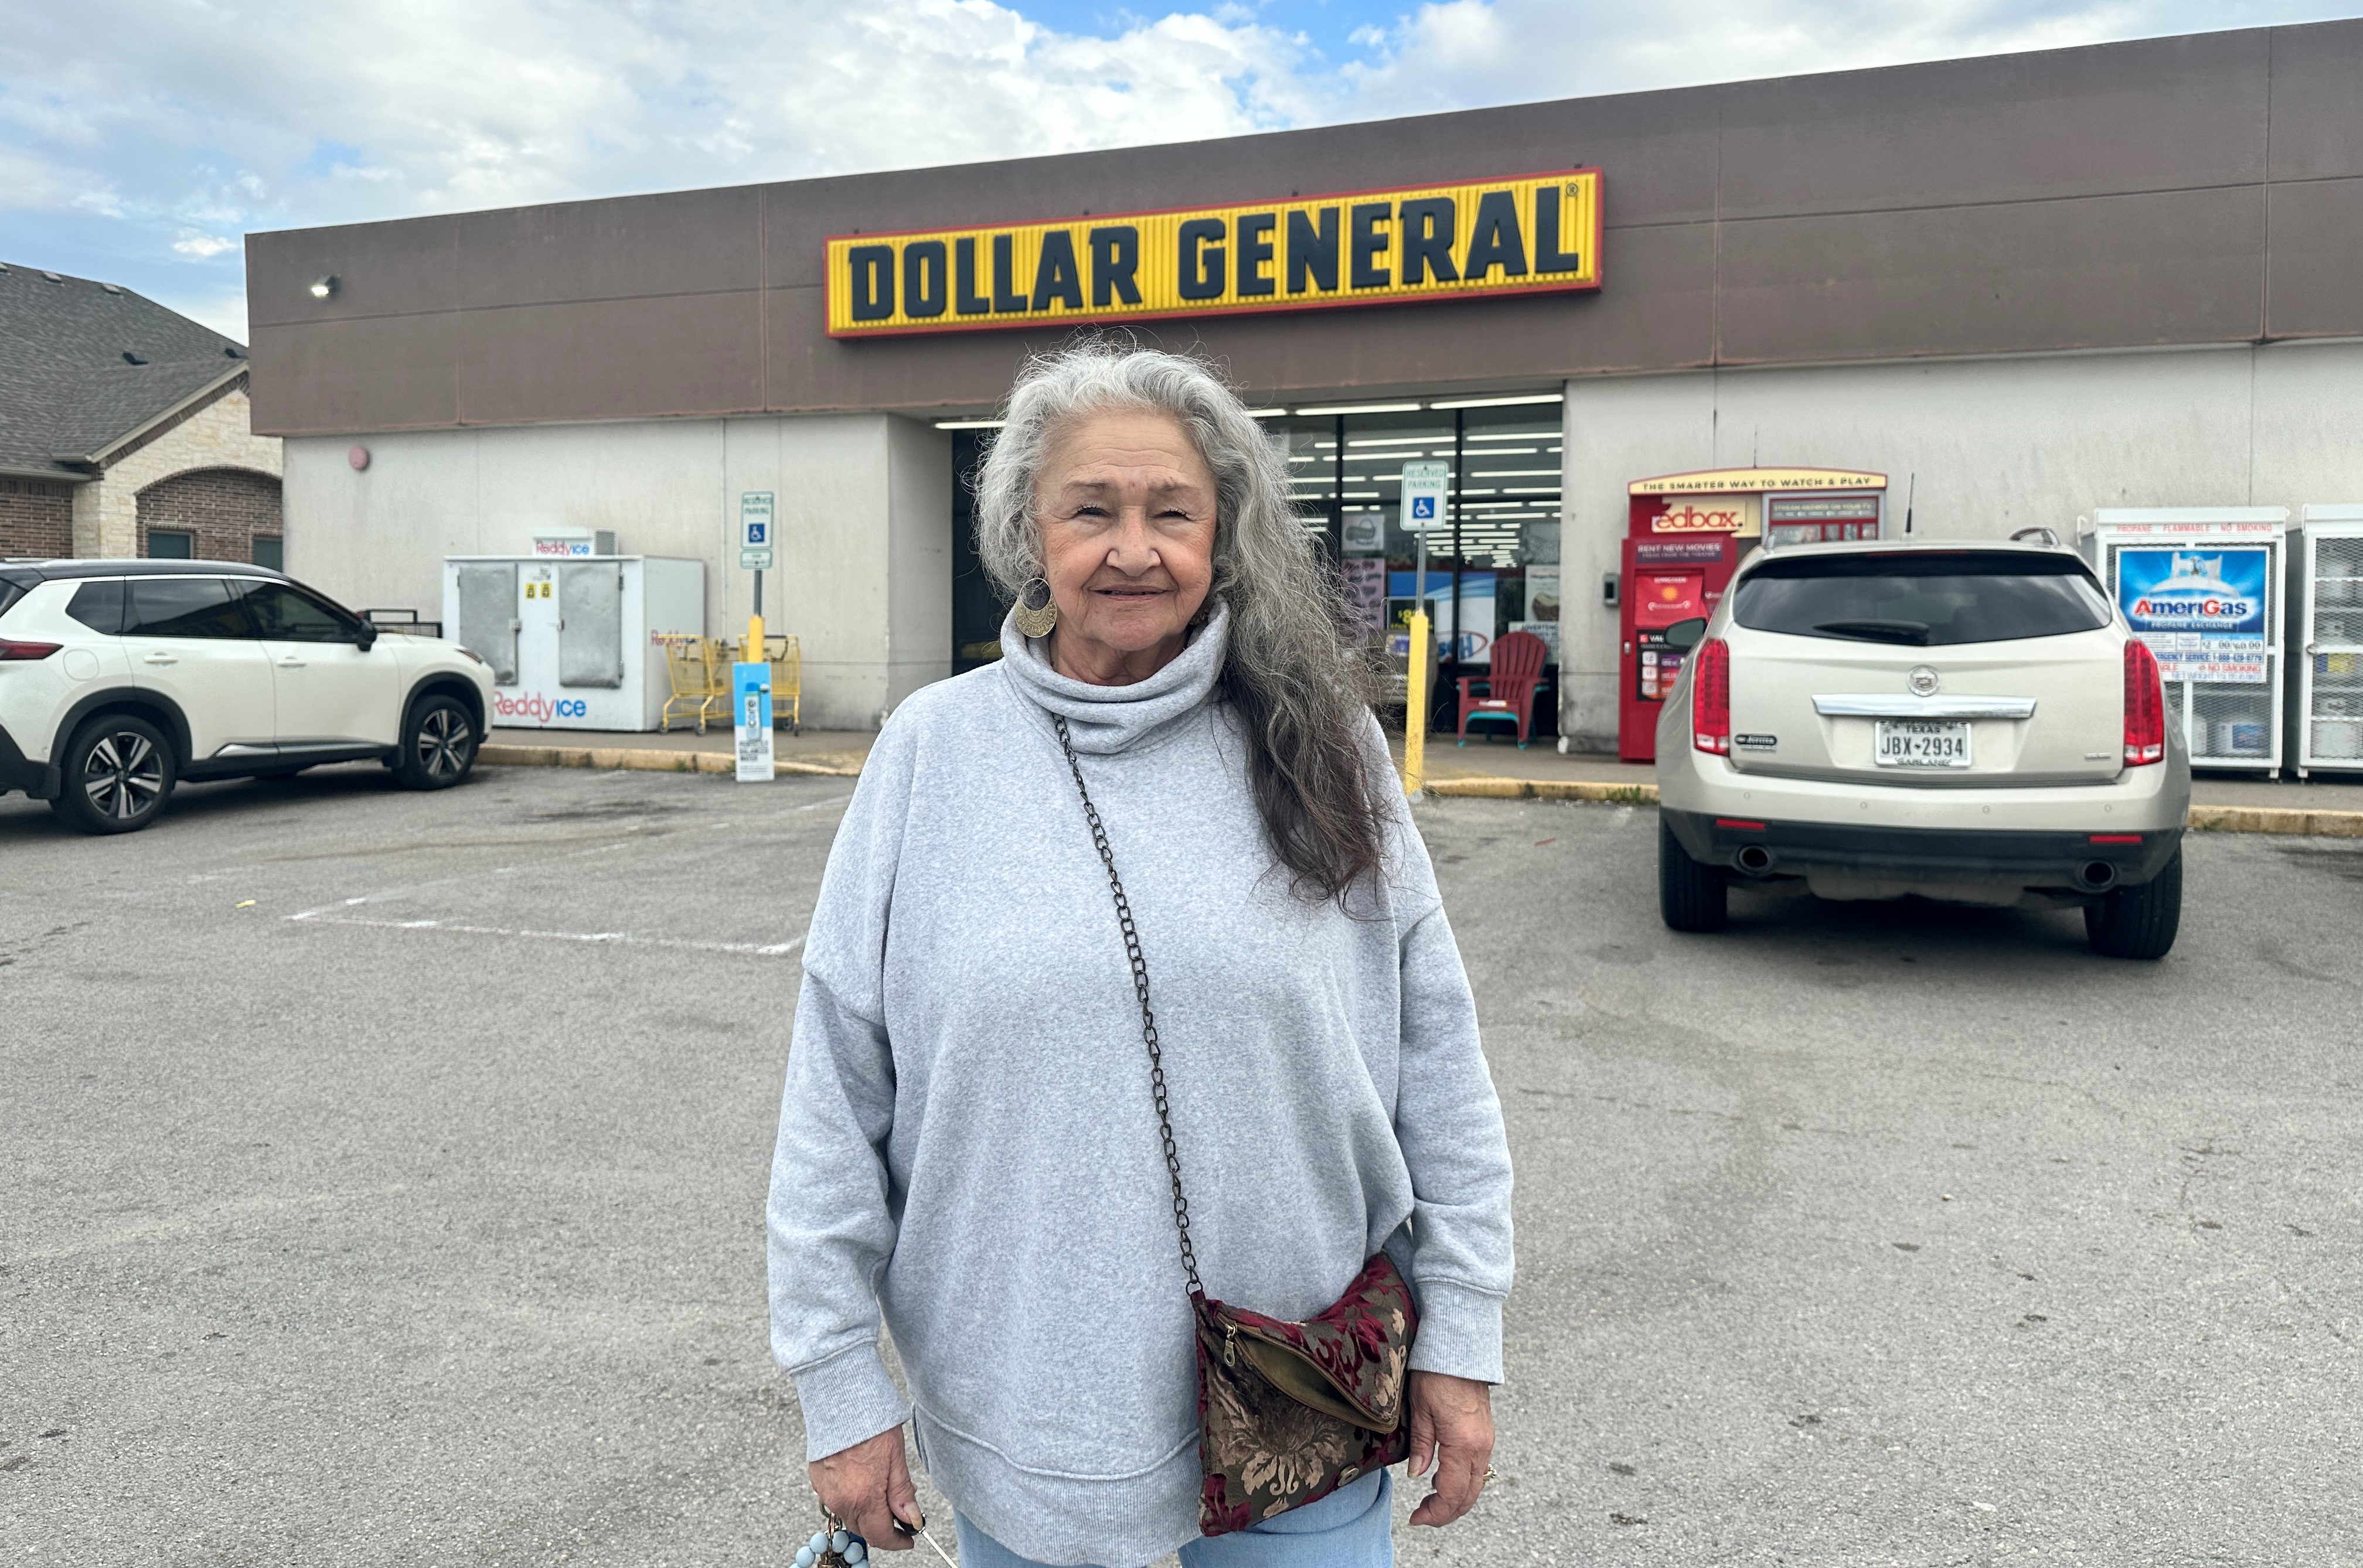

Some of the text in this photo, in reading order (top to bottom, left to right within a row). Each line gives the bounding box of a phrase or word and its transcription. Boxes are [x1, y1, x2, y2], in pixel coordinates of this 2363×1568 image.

[849, 186, 1578, 321] DOLLAR GENERAL
[1408, 480, 1441, 489] PARKING
[1669, 481, 1725, 490] SMARTER
[1729, 480, 1755, 488] WAY
[1781, 478, 1823, 486] WATCH
[1841, 477, 1871, 485] PLAY
[2116, 523, 2273, 532] PROPANE FLAMMABLE NO SMOKING
[1637, 543, 1722, 553] RENT NEW MOVIES
[2134, 598, 2248, 616] AmeriGas
[2151, 621, 2234, 630] PROPANE EXCHANGE
[2208, 663, 2220, 672] NO
[2222, 662, 2262, 673] SMOKING
[1905, 723, 1941, 734] TEXAS
